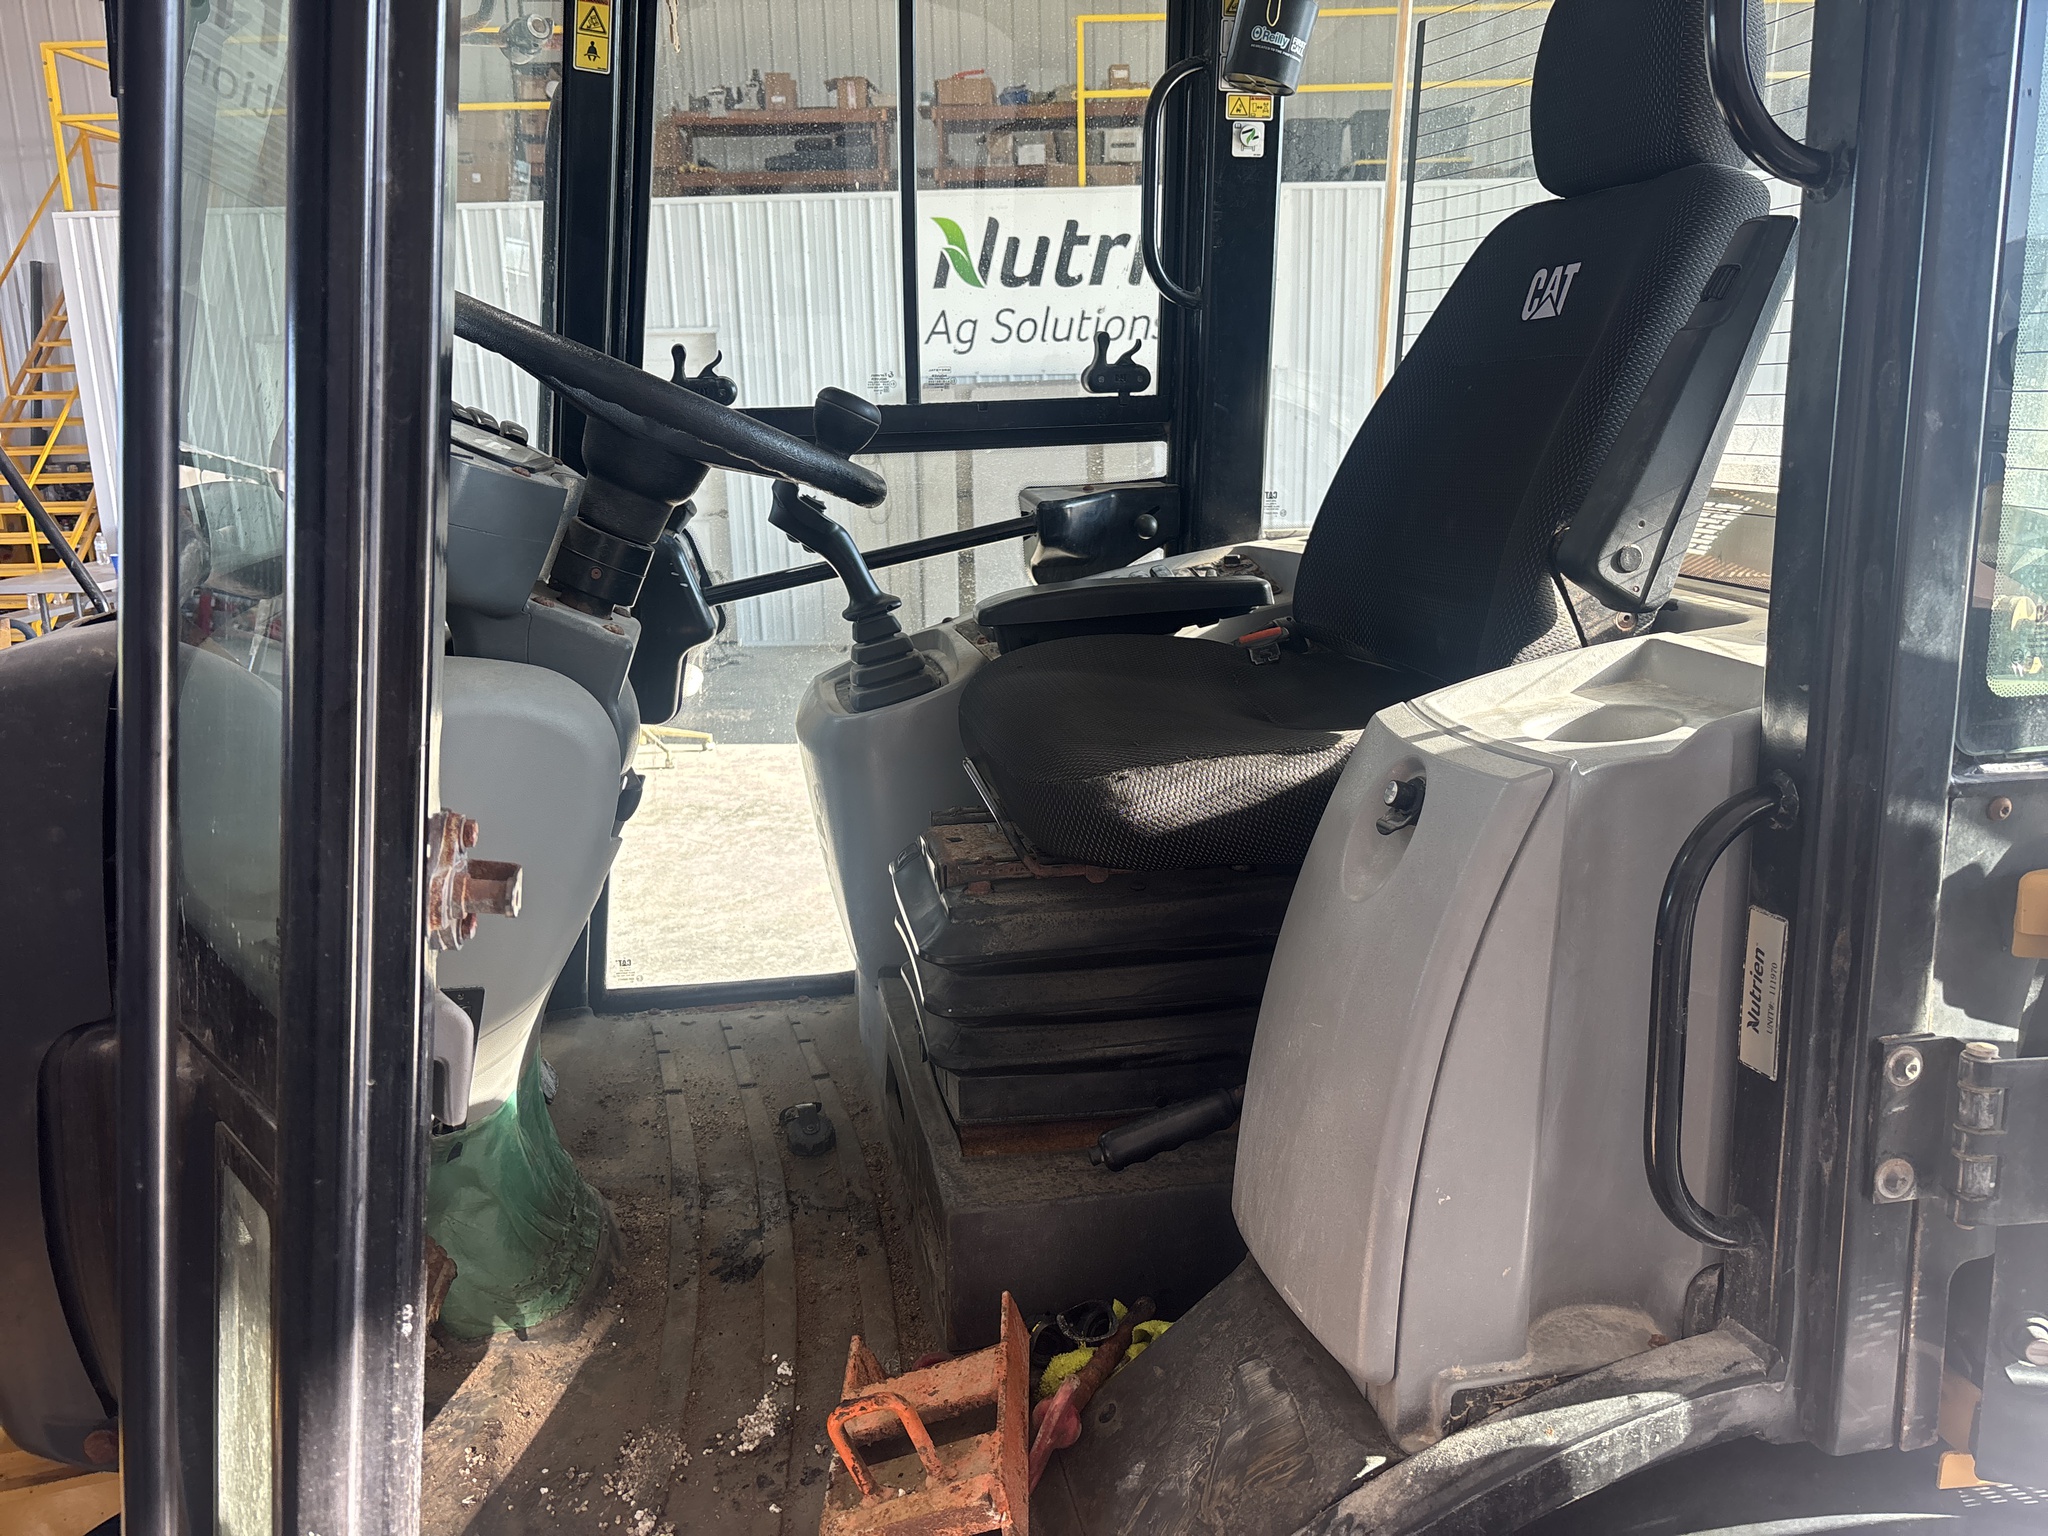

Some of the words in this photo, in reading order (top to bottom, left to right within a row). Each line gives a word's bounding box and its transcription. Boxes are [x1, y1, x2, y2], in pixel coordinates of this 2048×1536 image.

[1251, 25, 1290, 49] O'Reilly
[1521, 261, 1582, 321] CAT
[924, 309, 979, 355] Ag
[1746, 947, 1765, 1035] Nutrien
[1769, 962, 1778, 996] 111970
